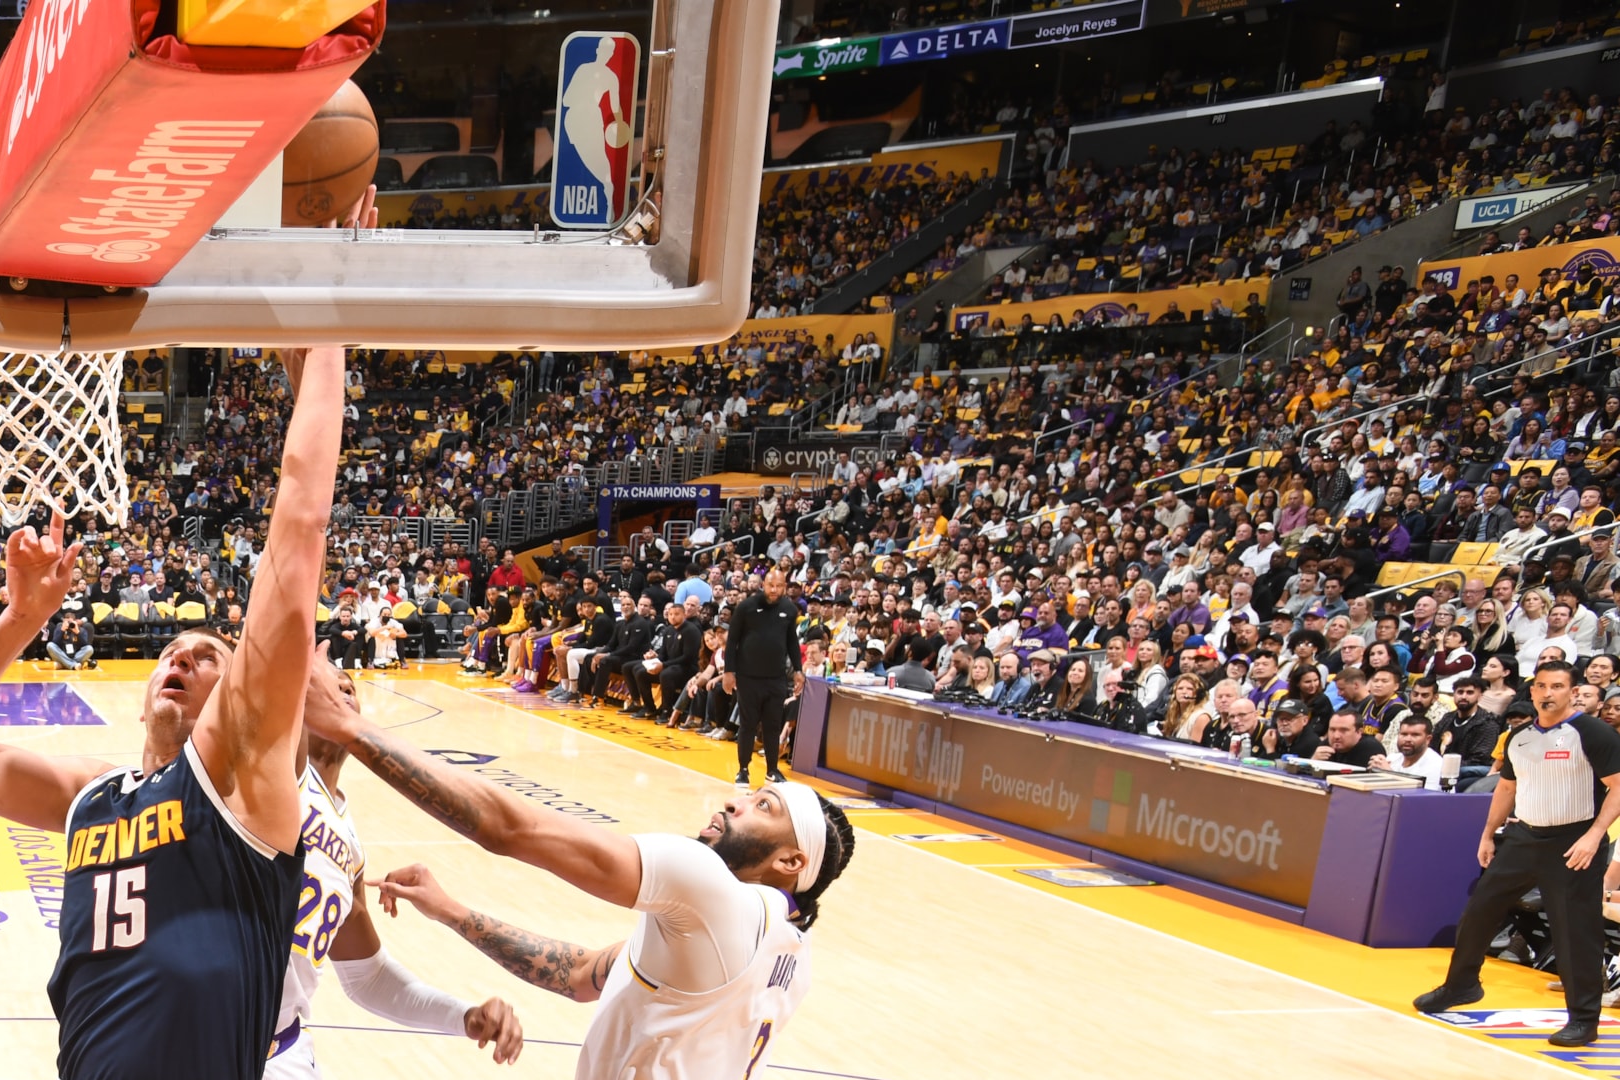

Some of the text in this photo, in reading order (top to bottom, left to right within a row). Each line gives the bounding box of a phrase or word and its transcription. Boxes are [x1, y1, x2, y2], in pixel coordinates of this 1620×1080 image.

[917, 28, 999, 54] DELTA
[1036, 18, 1117, 38] Jocelyn Reyes
[814, 45, 867, 70] Sprite
[561, 185, 598, 215] NBA
[1478, 203, 1511, 218] UCLA
[613, 486, 697, 498] 17x CHAMPIONS
[846, 707, 1283, 871] GET THE App Powered by Microsoft
[66, 799, 187, 872] DENVER
[91, 864, 147, 952] 15
